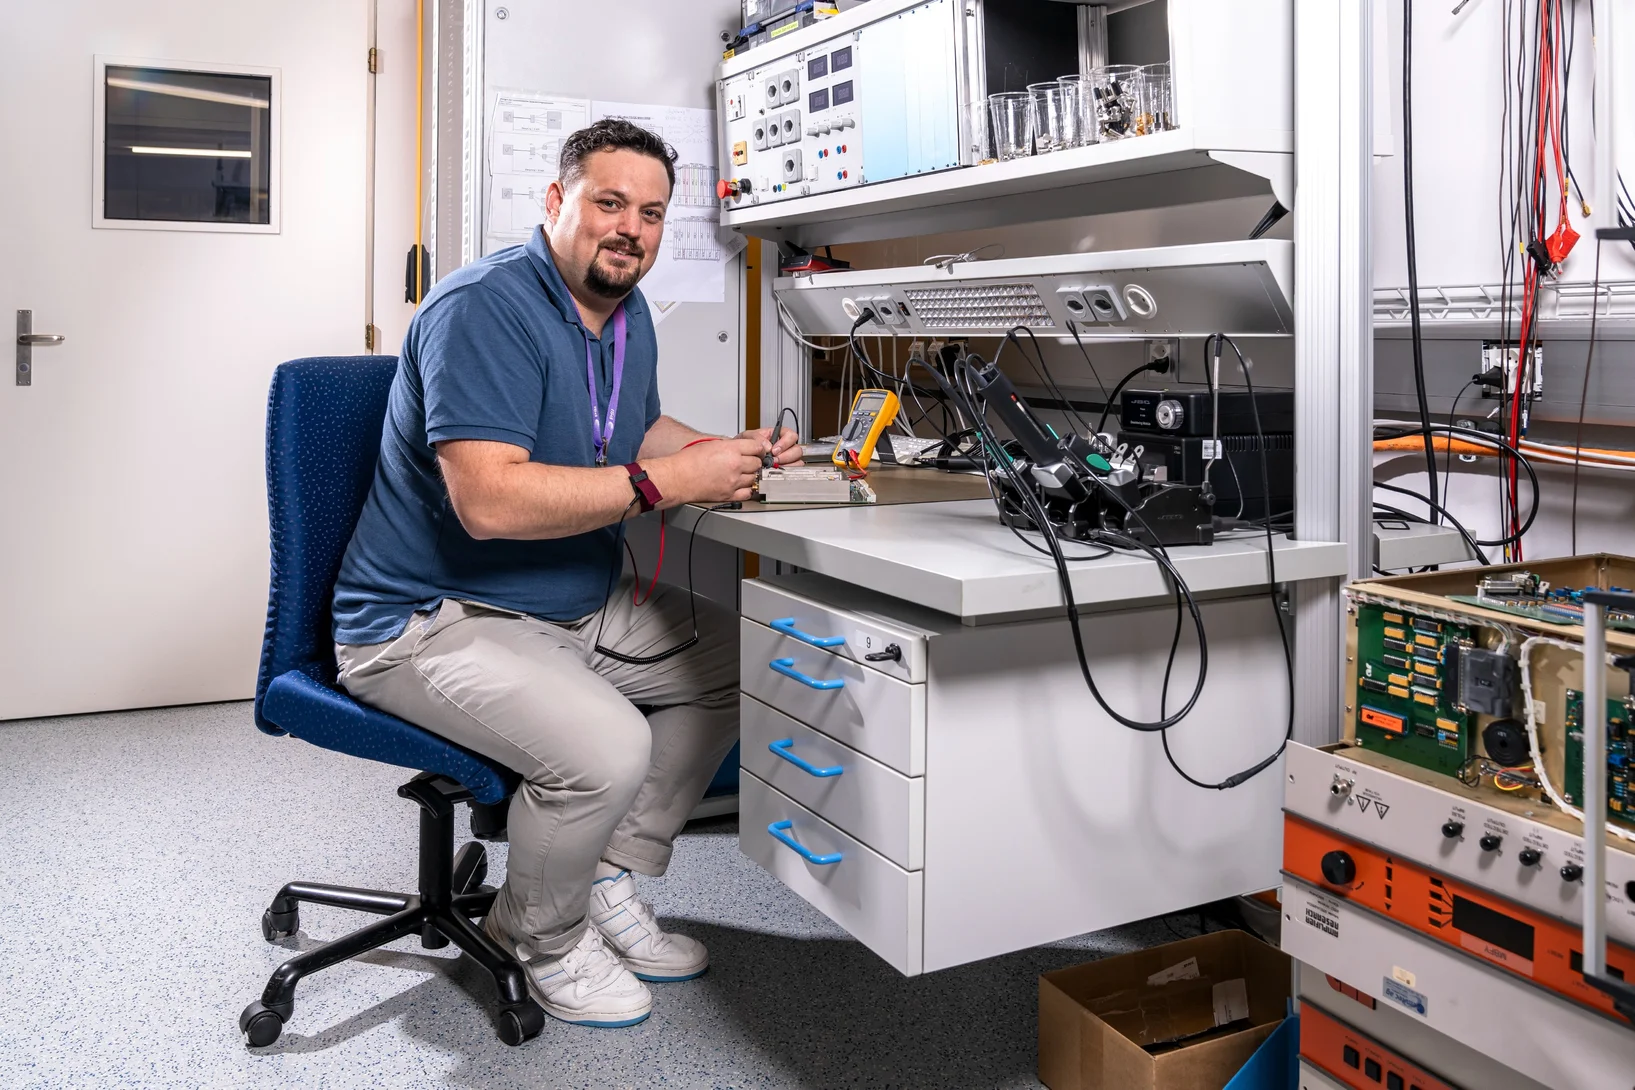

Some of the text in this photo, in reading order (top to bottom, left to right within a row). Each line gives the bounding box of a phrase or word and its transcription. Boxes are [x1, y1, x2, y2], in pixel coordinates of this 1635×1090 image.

[866, 636, 871, 649] 9
[1335, 764, 1350, 773] OUTPUT
[1483, 822, 1509, 835] DETECTED
[1486, 817, 1506, 827] OUTPUT
[1522, 836, 1549, 849] DETECTED
[1528, 833, 1543, 841] INPUT
[1305, 907, 1339, 930] RESEARCH
[1305, 916, 1339, 938] AMPLIFIER
